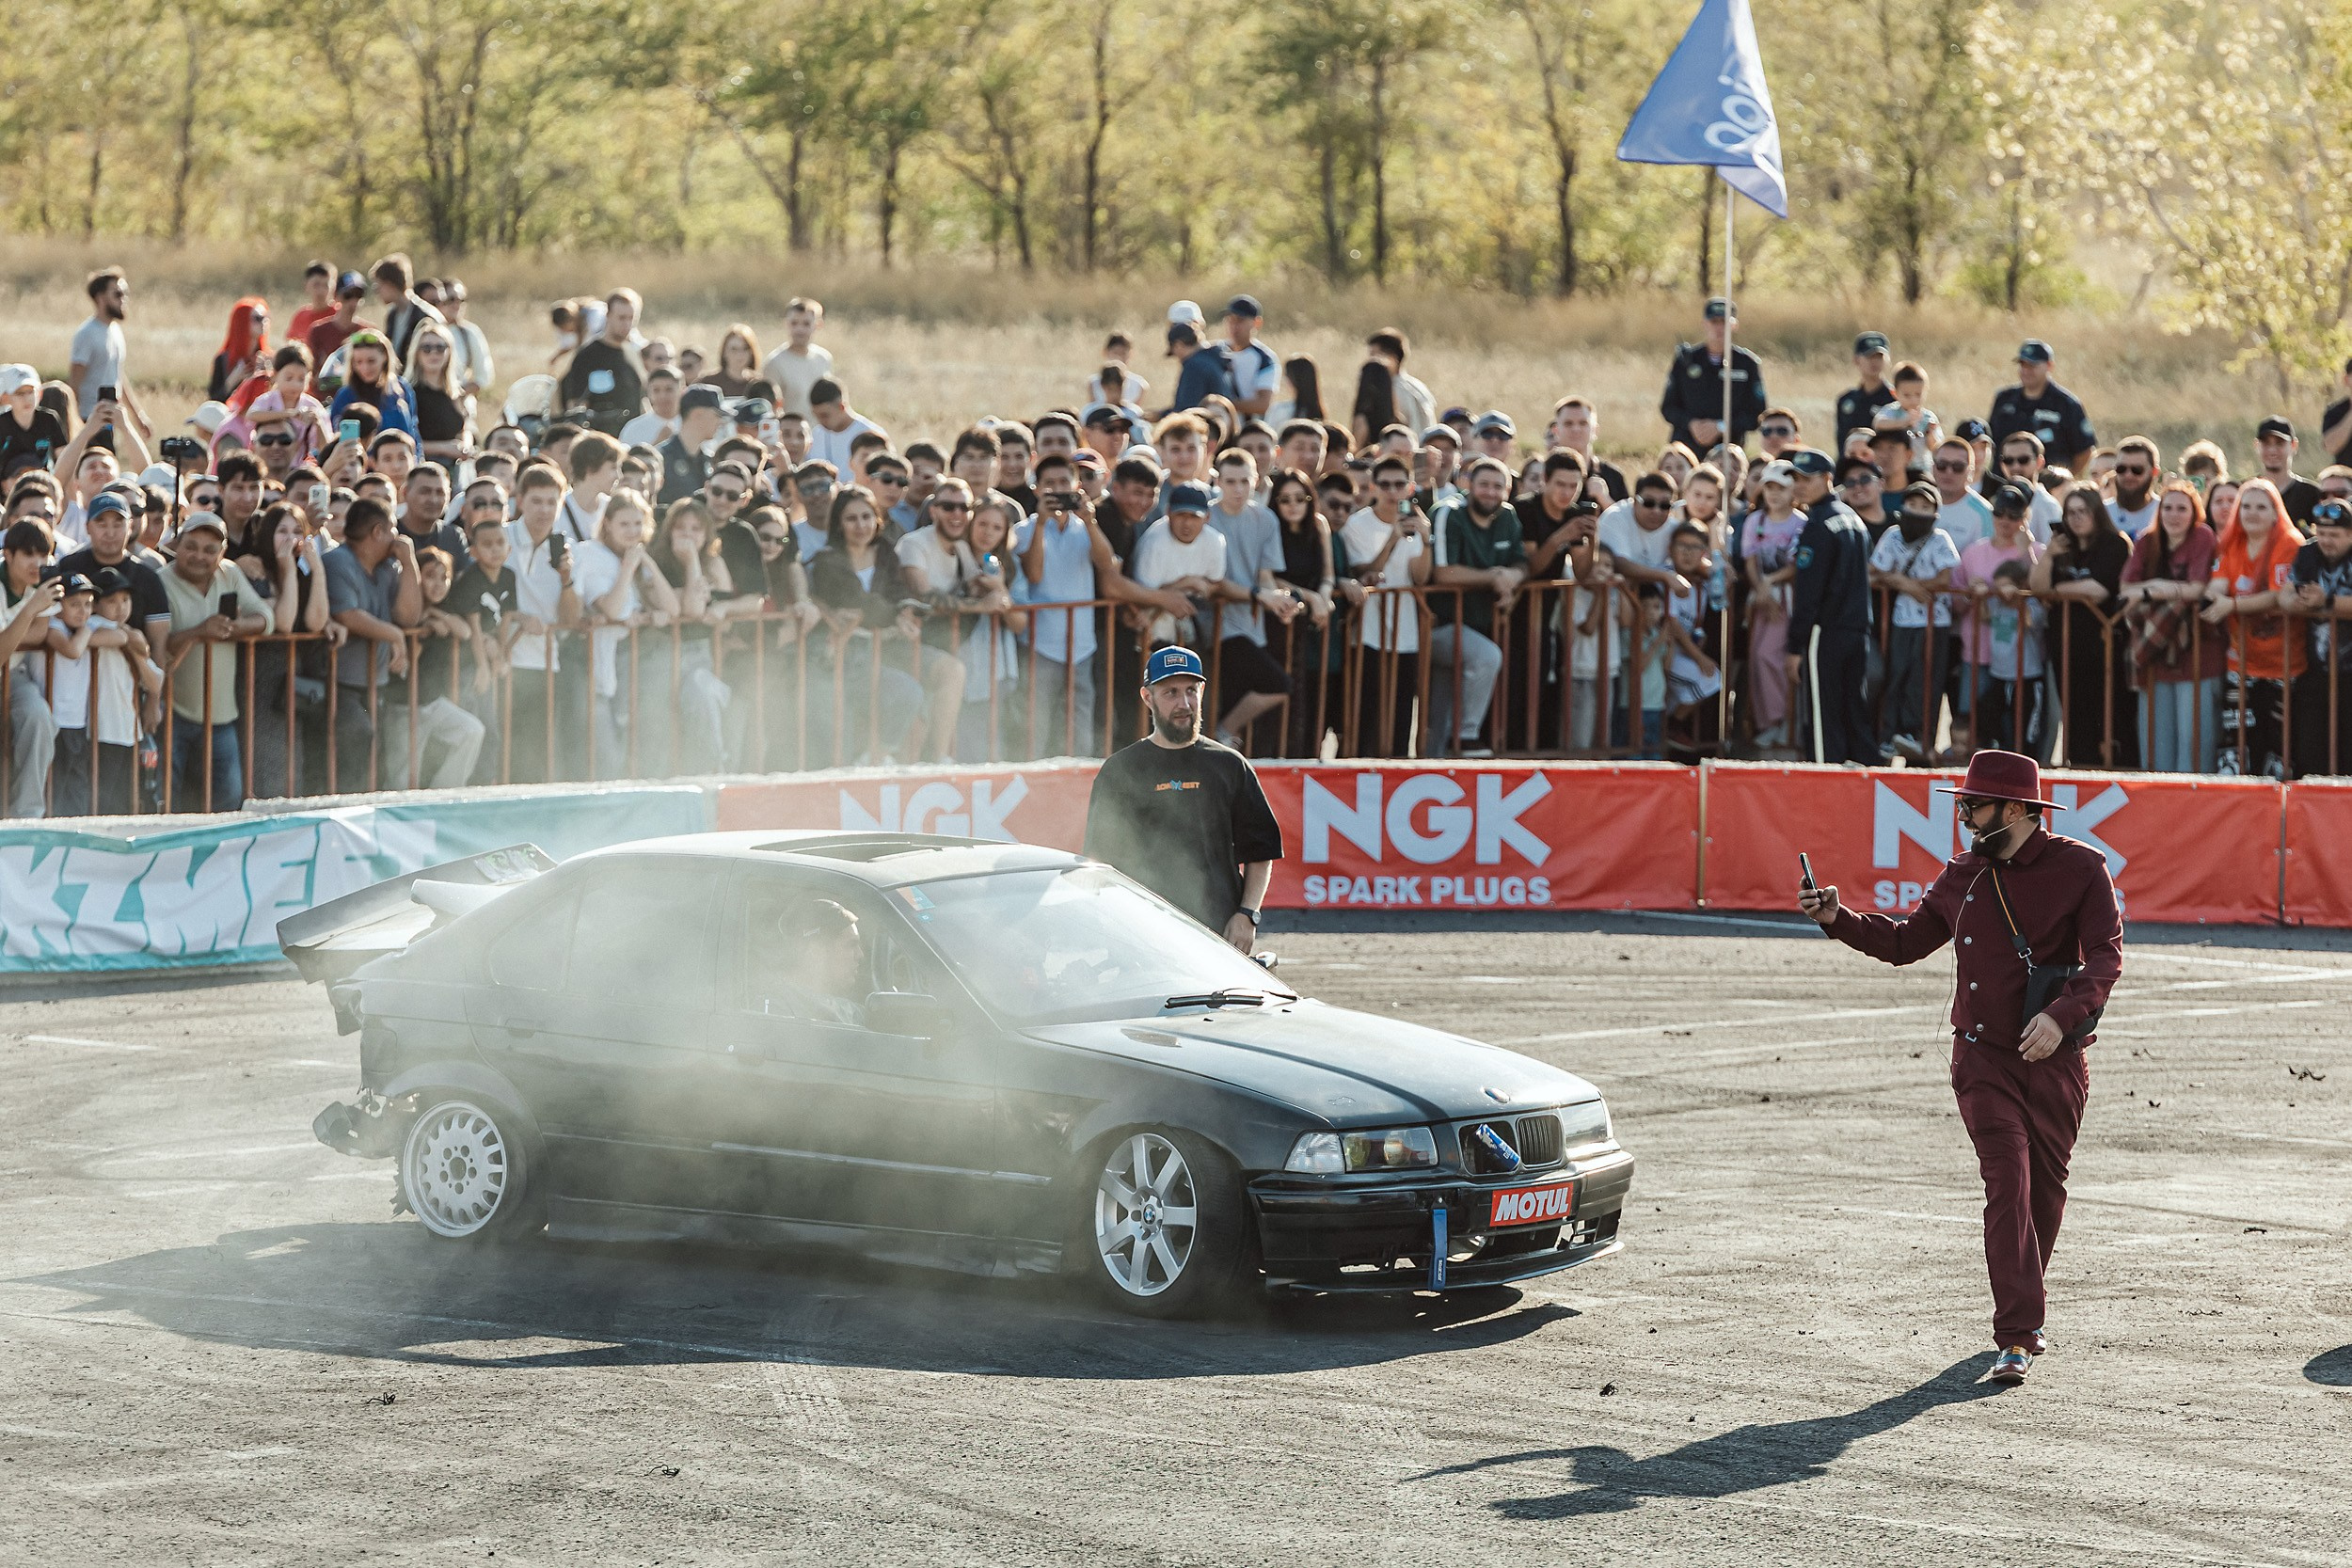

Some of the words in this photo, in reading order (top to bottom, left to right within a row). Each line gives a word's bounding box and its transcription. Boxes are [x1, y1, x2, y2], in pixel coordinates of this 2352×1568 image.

[1302, 769, 1553, 868] NGK
[1872, 778, 2130, 879] NK
[1303, 874, 1423, 904] SPARK
[1430, 875, 1551, 904] PLUGS
[1494, 1186, 1569, 1222] MOTUL
